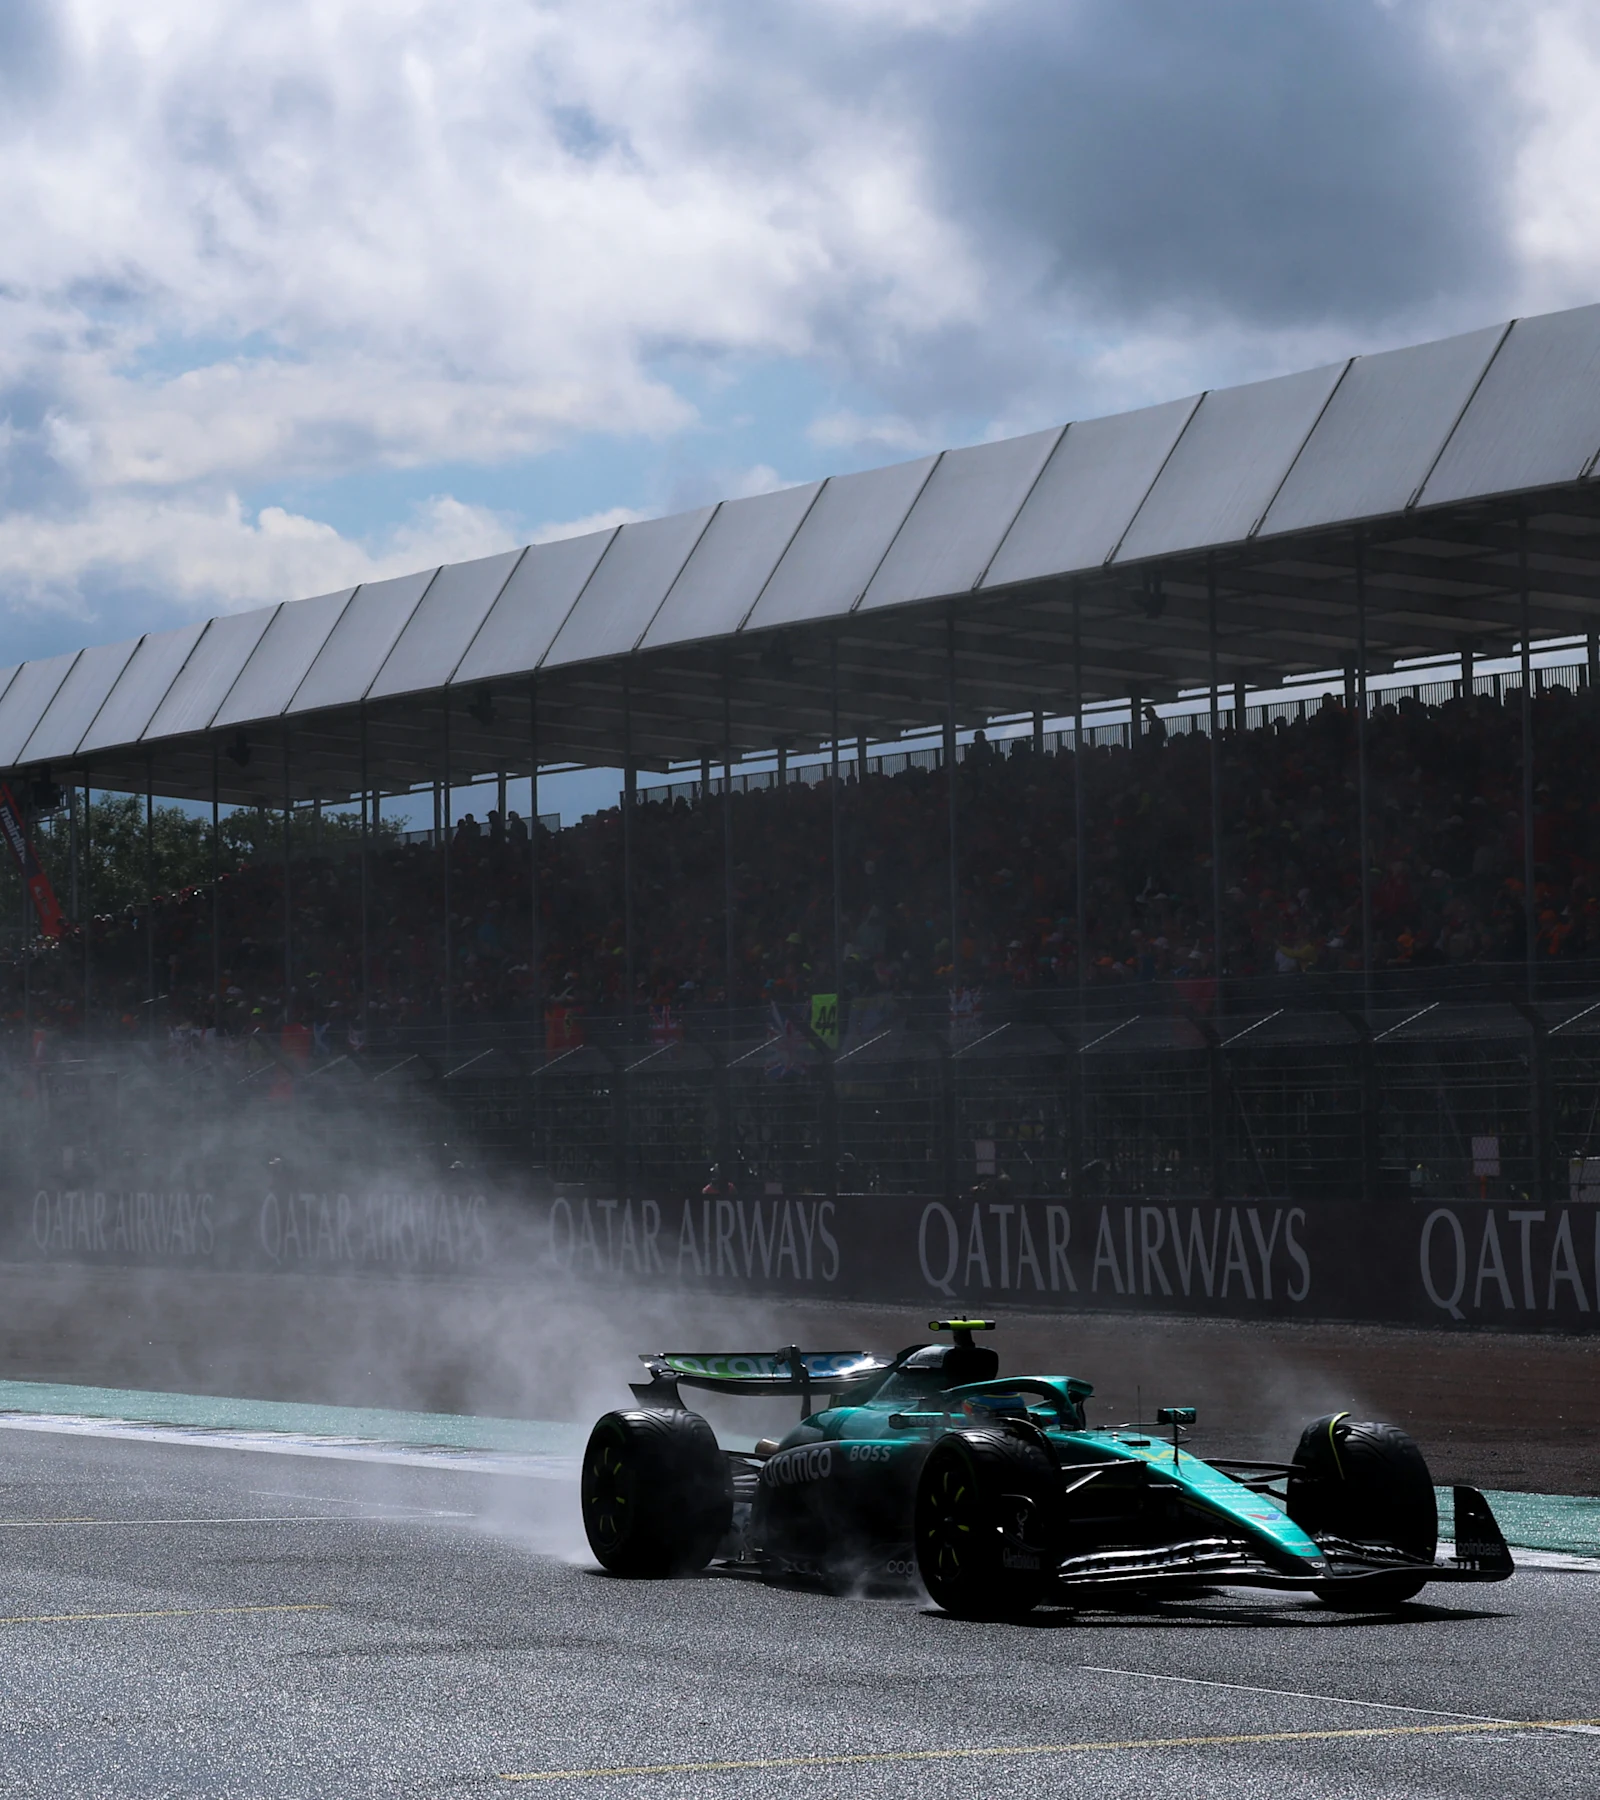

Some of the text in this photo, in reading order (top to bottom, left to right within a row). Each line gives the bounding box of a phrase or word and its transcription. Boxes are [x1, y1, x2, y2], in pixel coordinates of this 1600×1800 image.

[815, 1005, 837, 1036] 44
[32, 1189, 214, 1256] QATAR AIRWAYS
[260, 1192, 487, 1266] QATAR AIRWAYS
[548, 1197, 840, 1281] QATAR AIRWAYS
[918, 1201, 1311, 1302] QATAR AIRWAYS
[1420, 1207, 1600, 1320] QATA
[908, 1416, 941, 1426] BOSS
[764, 1447, 832, 1488] aramco
[849, 1445, 892, 1463] BOSS
[1457, 1538, 1503, 1556] coinbase
